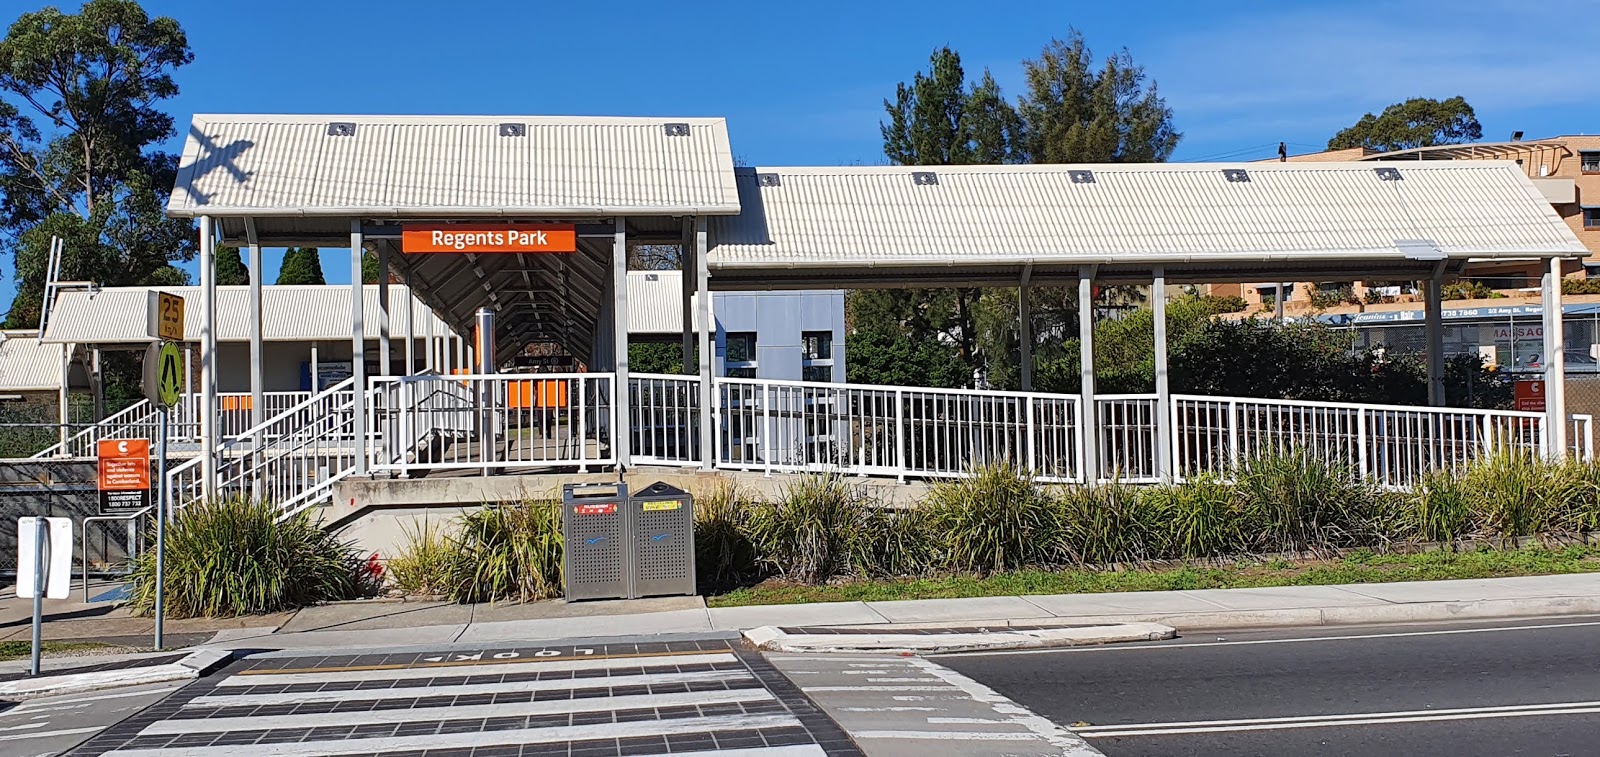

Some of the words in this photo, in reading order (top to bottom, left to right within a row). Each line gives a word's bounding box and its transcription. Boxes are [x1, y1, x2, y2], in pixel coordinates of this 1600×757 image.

[432, 230, 504, 249] Regents
[508, 230, 547, 246] Park
[163, 298, 179, 323] 25
[1400, 310, 1414, 320] Hair
[455, 648, 593, 662] LOOK
